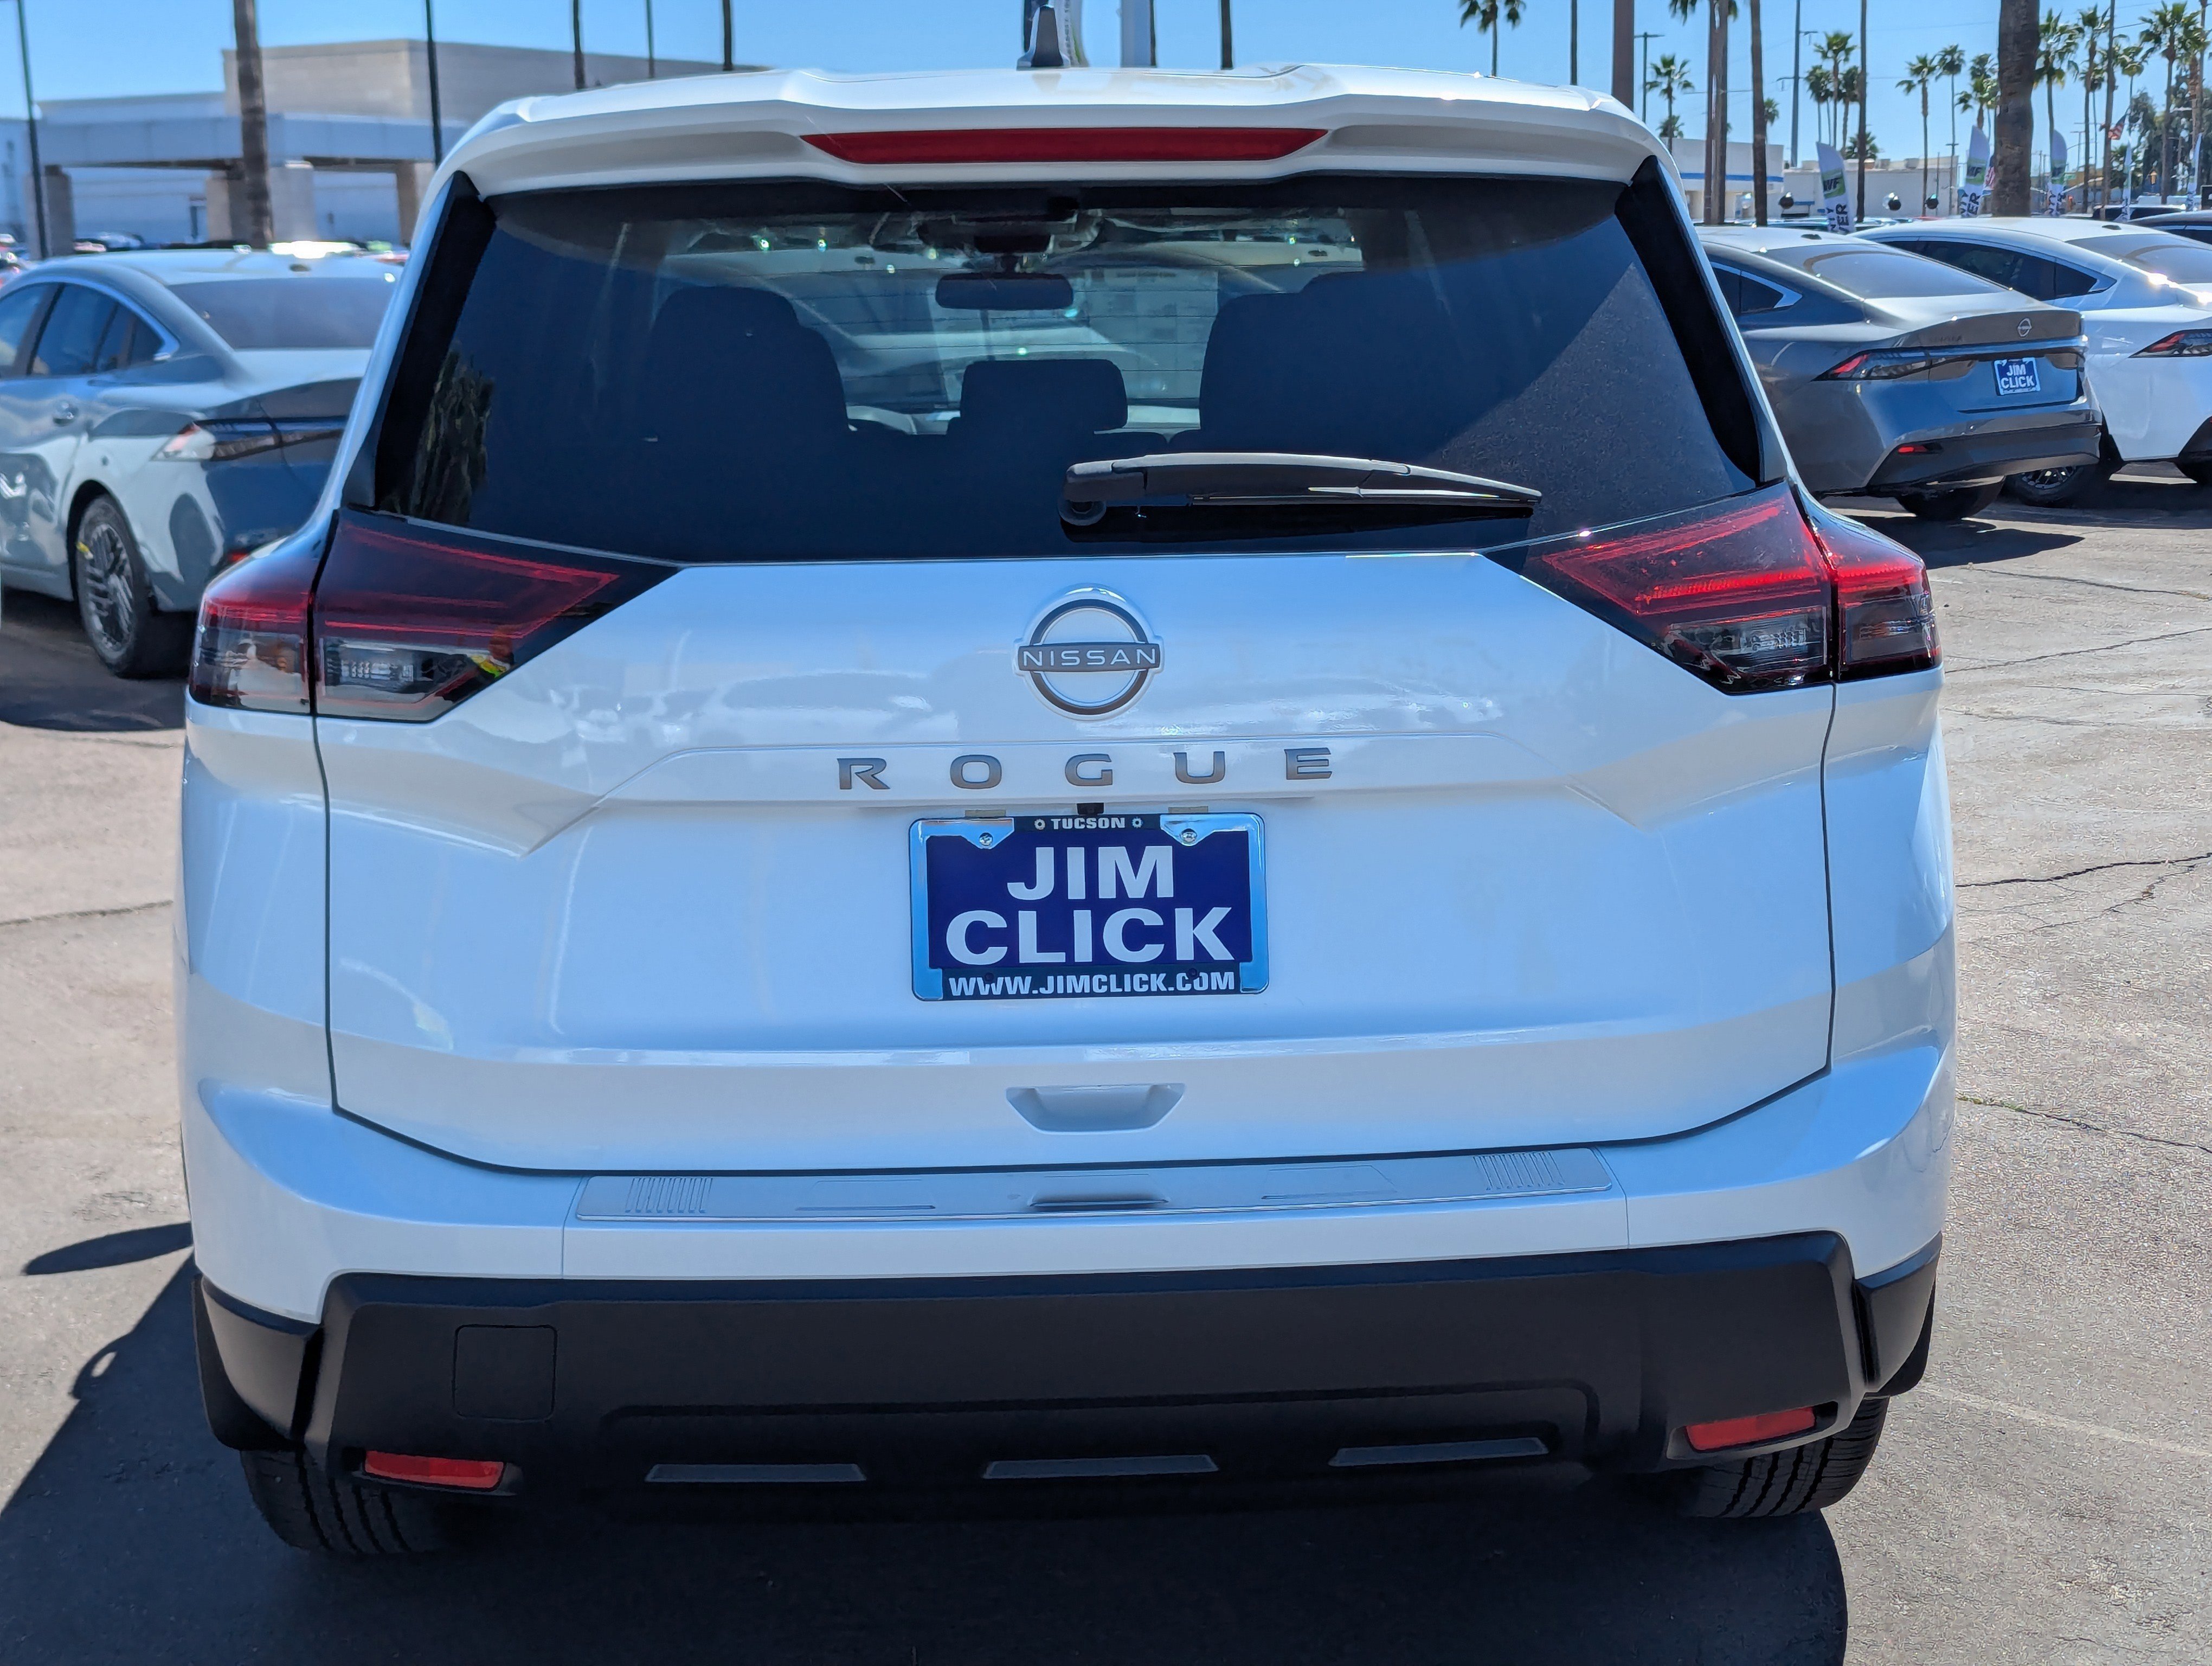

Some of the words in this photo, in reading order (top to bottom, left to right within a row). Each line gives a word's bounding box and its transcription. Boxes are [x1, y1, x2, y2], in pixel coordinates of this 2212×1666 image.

[2007, 364, 2026, 376] JIM
[2001, 375, 2035, 389] CLICK
[1023, 649, 1156, 666] NISSAN
[837, 747, 1332, 790] ROGUE
[1051, 817, 1126, 830] TUCSON
[1007, 845, 1174, 900] JIM
[946, 907, 1234, 965] CLICK
[948, 971, 1234, 996] WWW.JIMCLICK.COM
